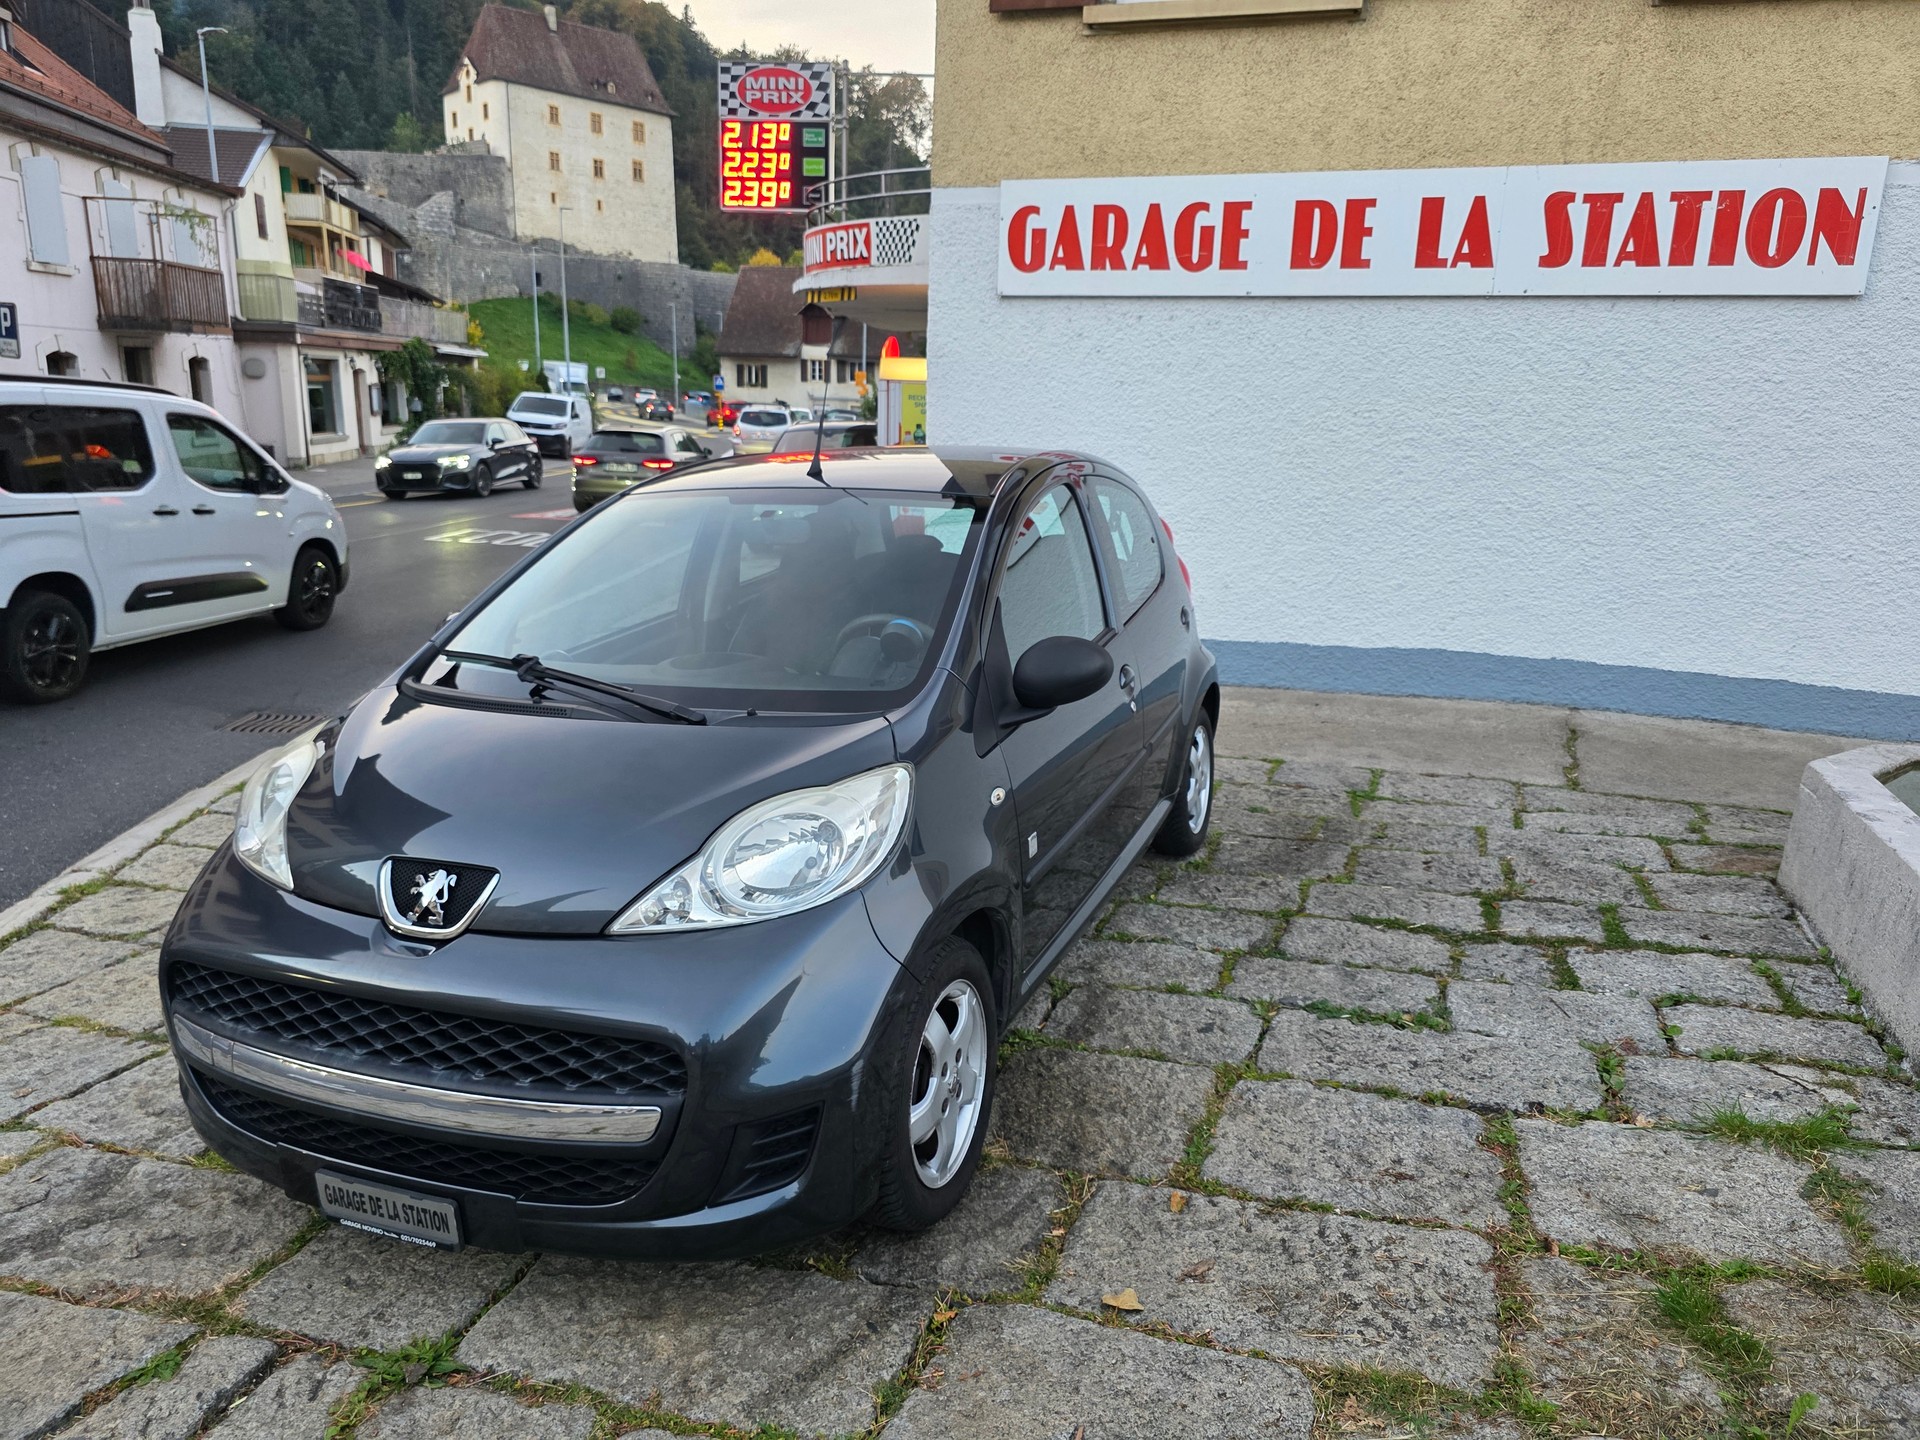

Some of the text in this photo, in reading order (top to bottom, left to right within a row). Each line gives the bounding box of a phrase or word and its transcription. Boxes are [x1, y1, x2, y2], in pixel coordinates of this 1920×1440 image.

[745, 76, 804, 90] MINI
[745, 90, 804, 105] PRIX
[826, 227, 869, 263] PRIX
[1007, 187, 1868, 273] GARAGE DE LA STATION
[1, 307, 11, 336] P
[324, 1184, 451, 1234] GARAGE DE LA STATION
